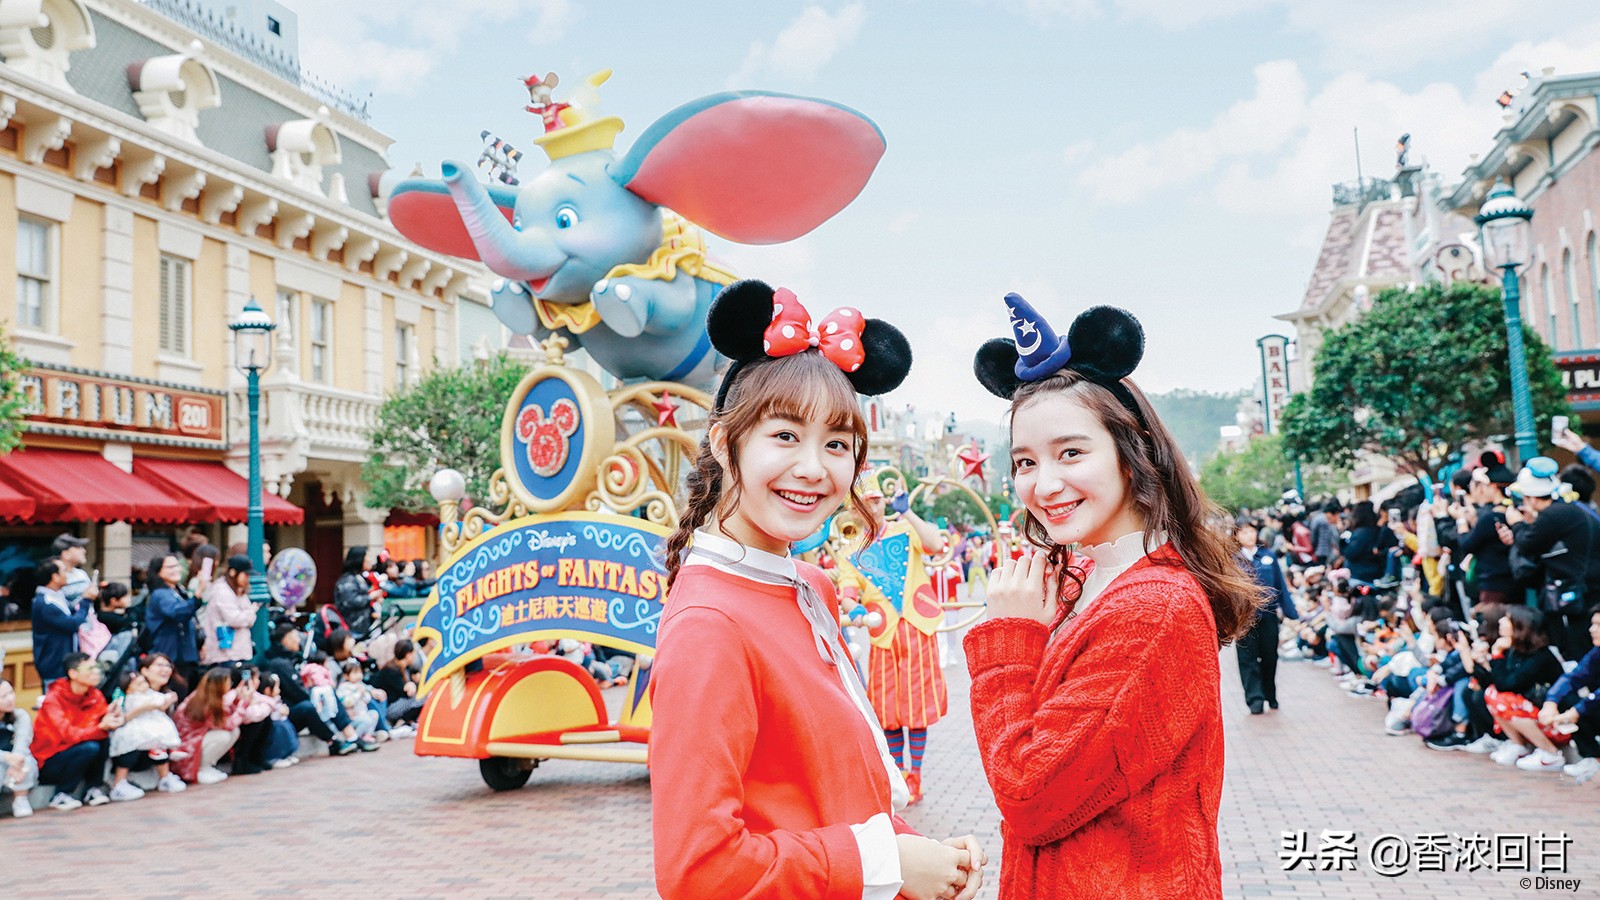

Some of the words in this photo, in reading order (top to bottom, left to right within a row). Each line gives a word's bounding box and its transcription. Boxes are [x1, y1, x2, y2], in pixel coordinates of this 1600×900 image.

[181, 403, 208, 428] 201
[525, 529, 577, 554] Disney's
[456, 559, 539, 617] FLIGHTS
[541, 565, 556, 578] OF
[500, 595, 608, 628] 迪士尼飛天巡遊
